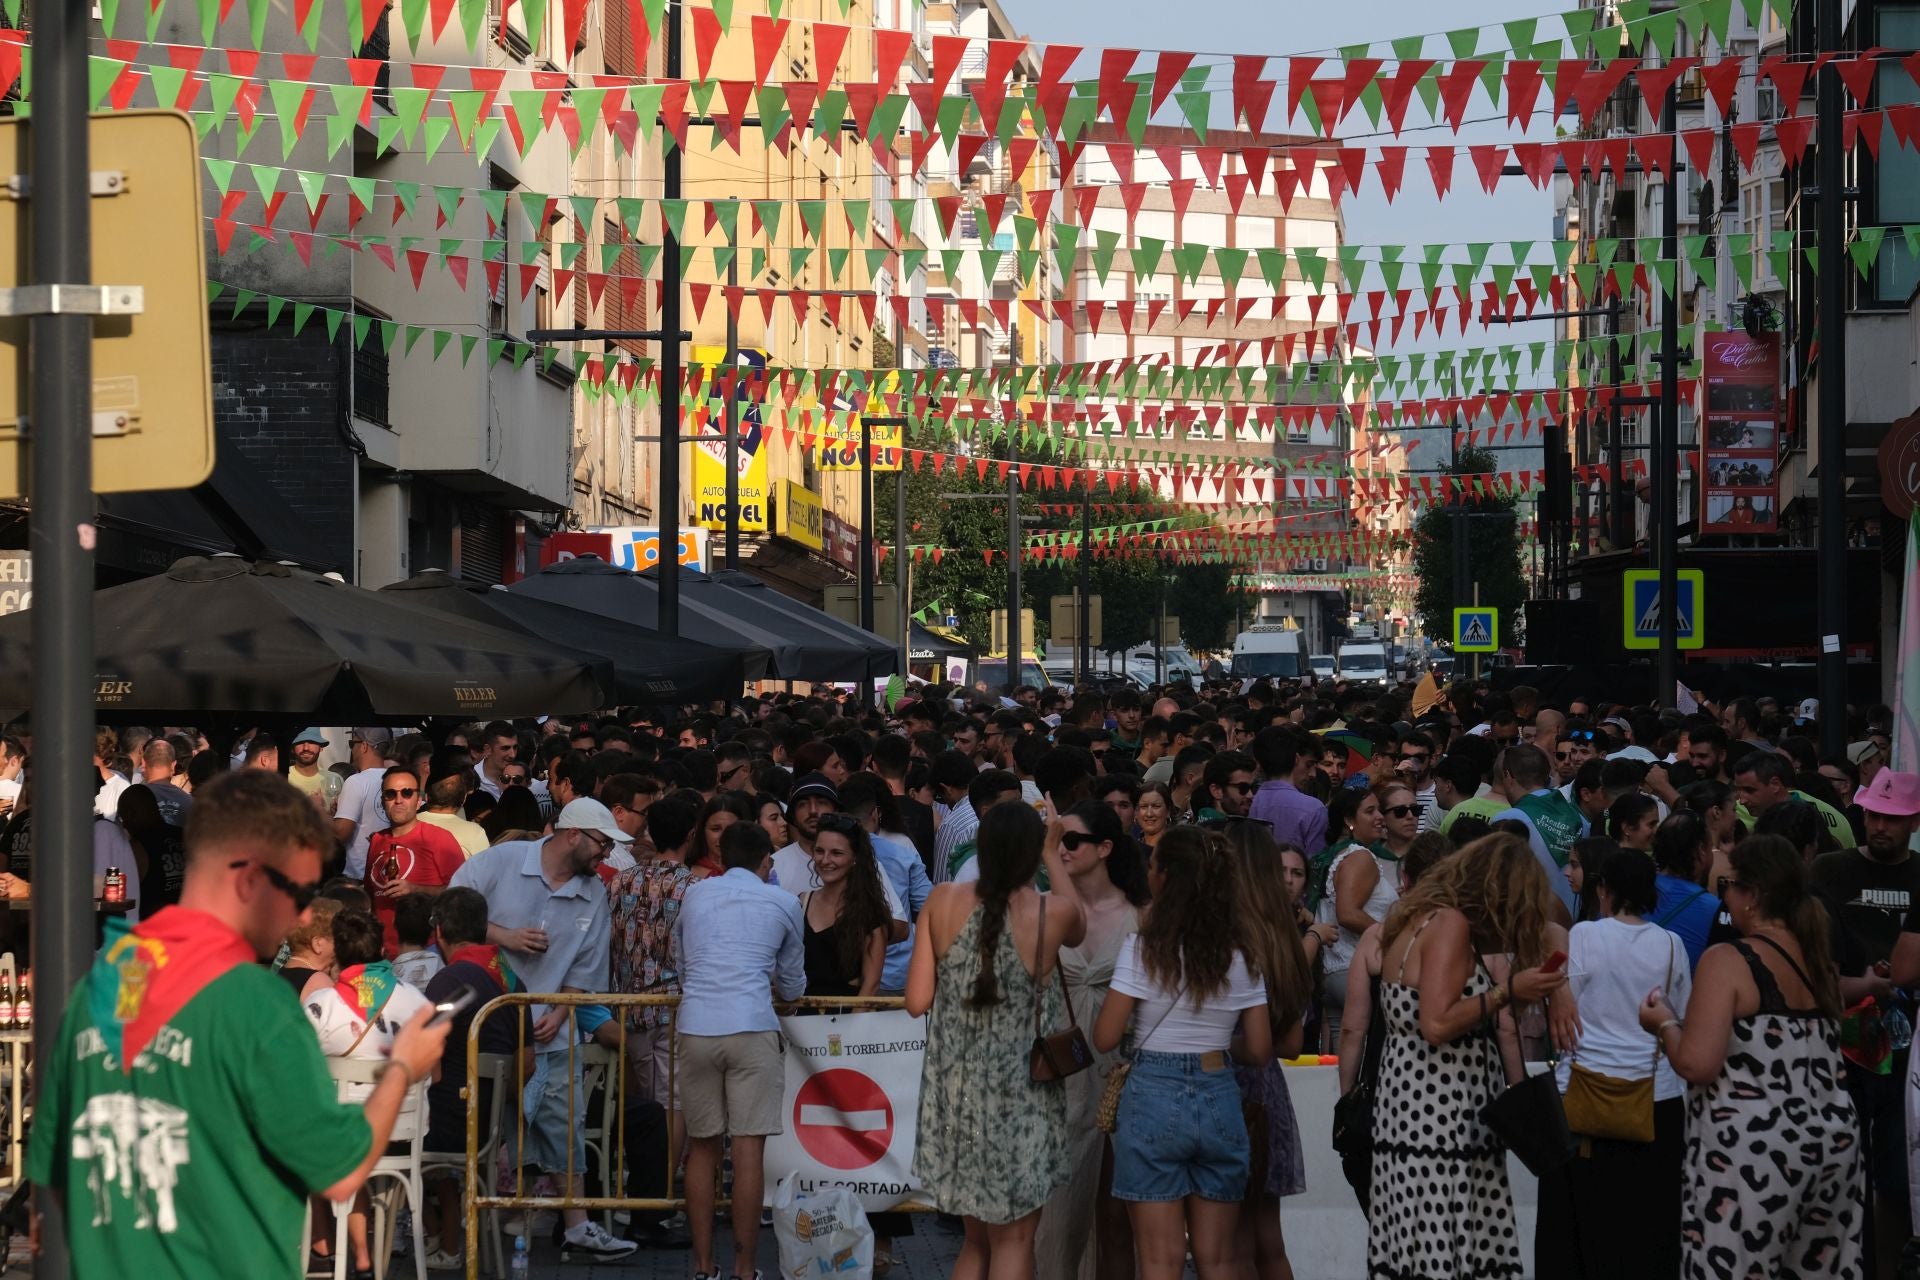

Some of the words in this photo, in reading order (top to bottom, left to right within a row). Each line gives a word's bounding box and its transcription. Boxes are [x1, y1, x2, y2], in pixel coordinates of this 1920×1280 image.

[909, 649, 935, 658] ízate
[453, 687, 497, 701] KELER
[1861, 889, 1910, 906] PUMA
[844, 1040, 927, 1056] TORRELAVEGA
